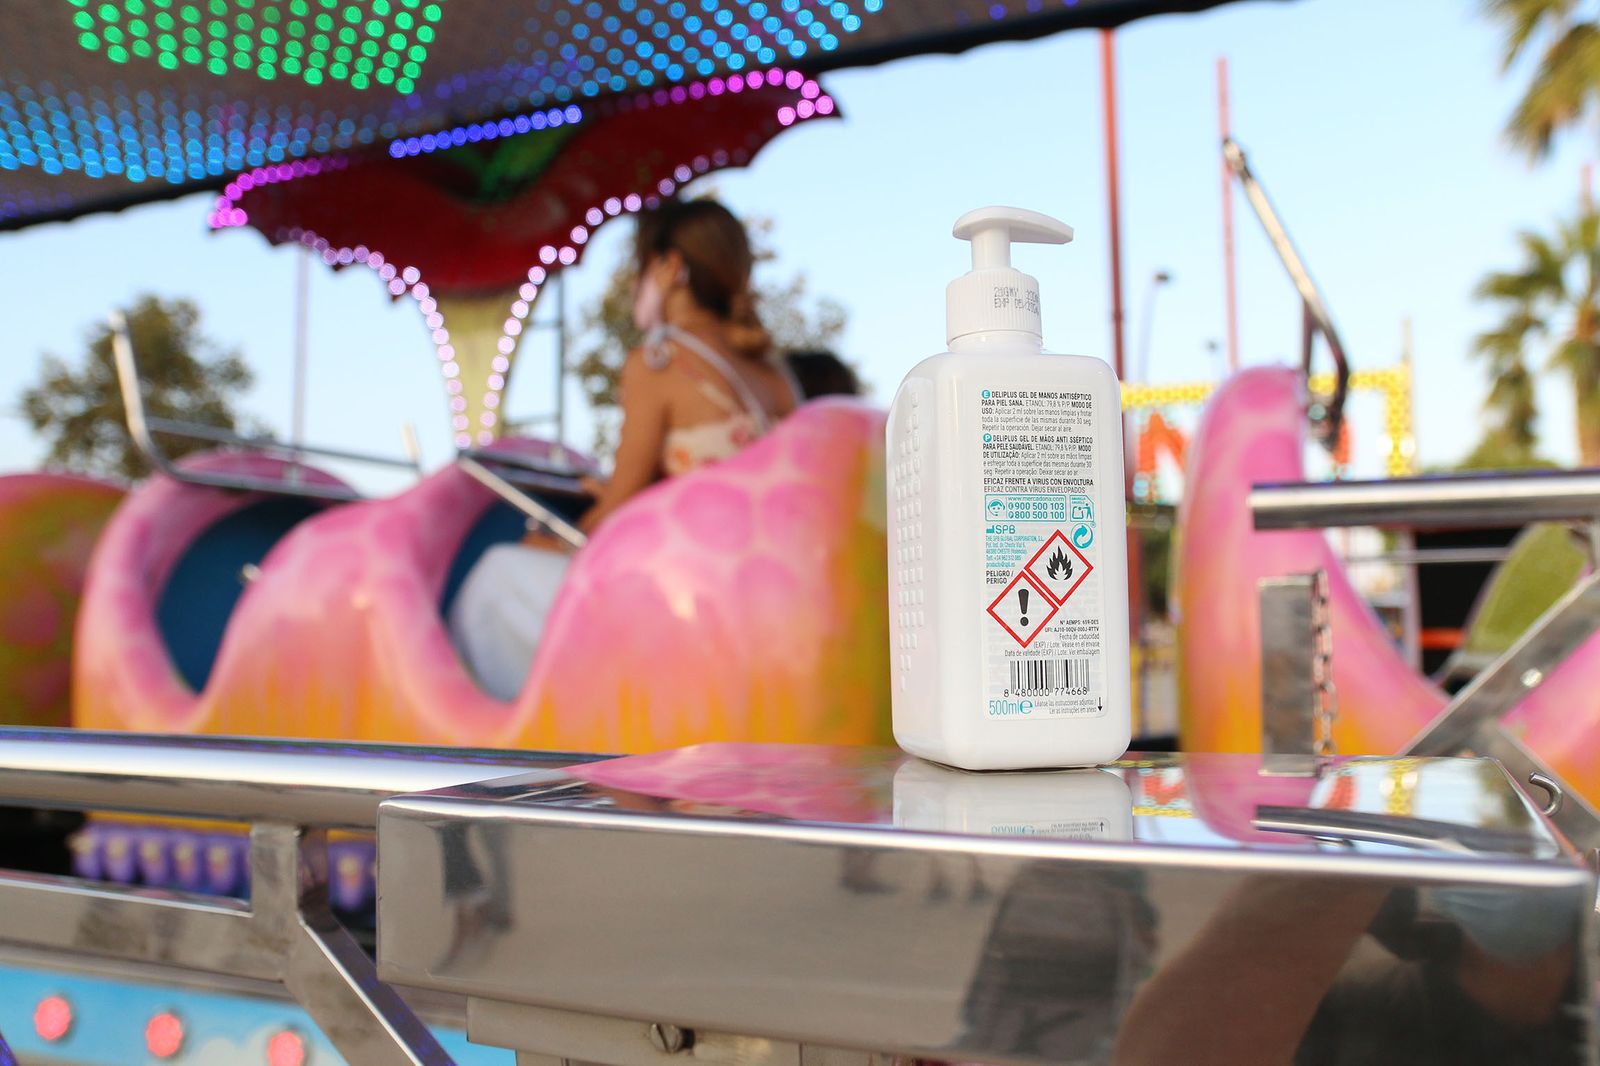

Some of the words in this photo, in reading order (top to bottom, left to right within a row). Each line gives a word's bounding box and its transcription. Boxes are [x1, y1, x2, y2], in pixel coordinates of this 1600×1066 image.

[1060, 392, 1091, 400] ANTISÉPTICO
[996, 525, 1015, 534] SPB
[1004, 689, 1009, 697] 8
[1015, 688, 1050, 697] 480000
[1055, 687, 1088, 695] 774668
[989, 700, 1019, 715] 500ml
